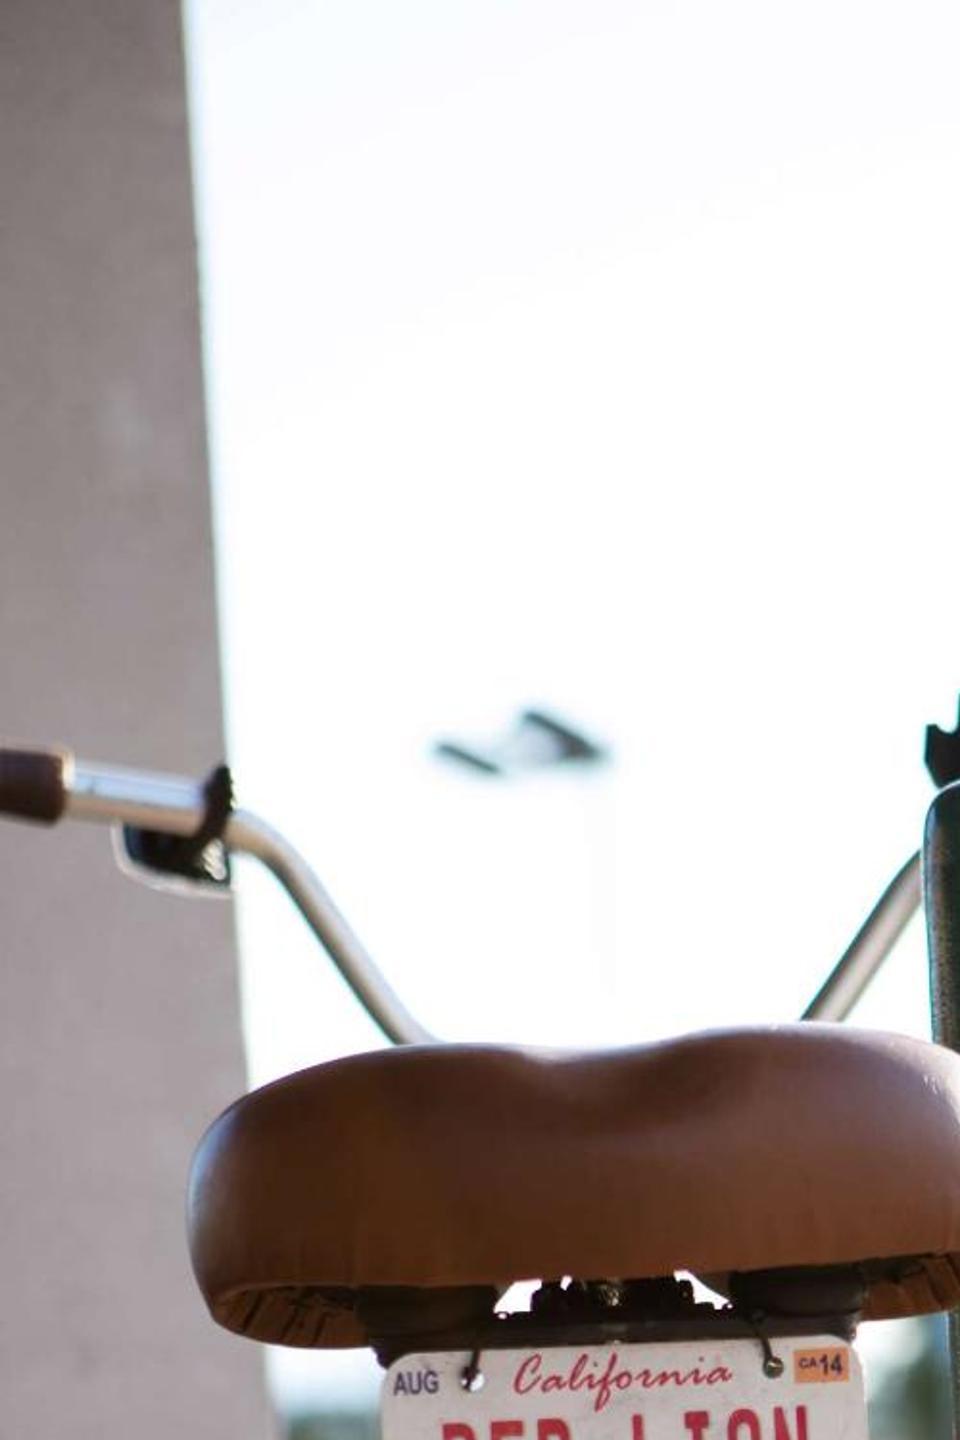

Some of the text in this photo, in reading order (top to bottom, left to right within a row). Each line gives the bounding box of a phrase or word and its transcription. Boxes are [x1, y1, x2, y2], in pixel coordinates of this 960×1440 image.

[819, 1352, 843, 1376] 14
[393, 1370, 439, 1396] AUG
[513, 1353, 734, 1411] California
